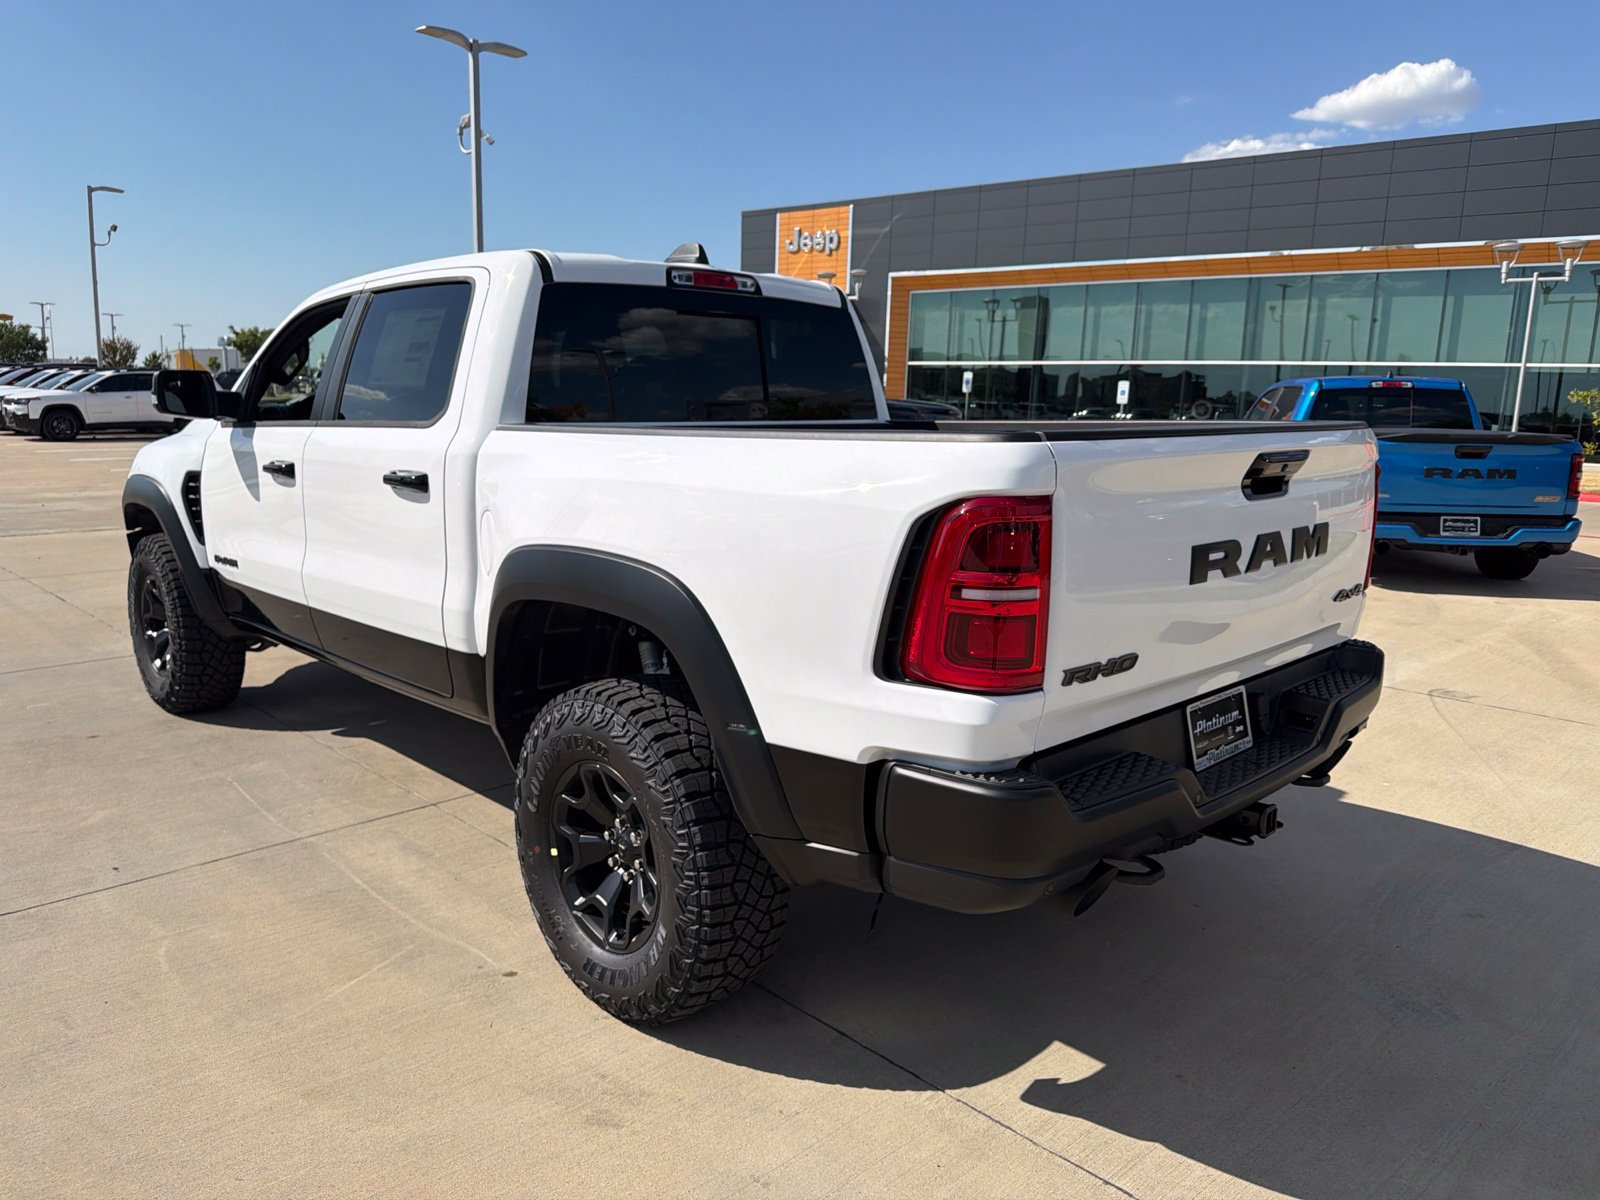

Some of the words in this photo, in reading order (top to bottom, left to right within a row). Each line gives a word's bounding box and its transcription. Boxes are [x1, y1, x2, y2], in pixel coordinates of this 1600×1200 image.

[785, 226, 839, 256] Jeep
[1424, 467, 1517, 479] RAM
[1189, 521, 1329, 585] RAM
[1061, 652, 1139, 687] RHO
[1194, 709, 1242, 736] Platinum
